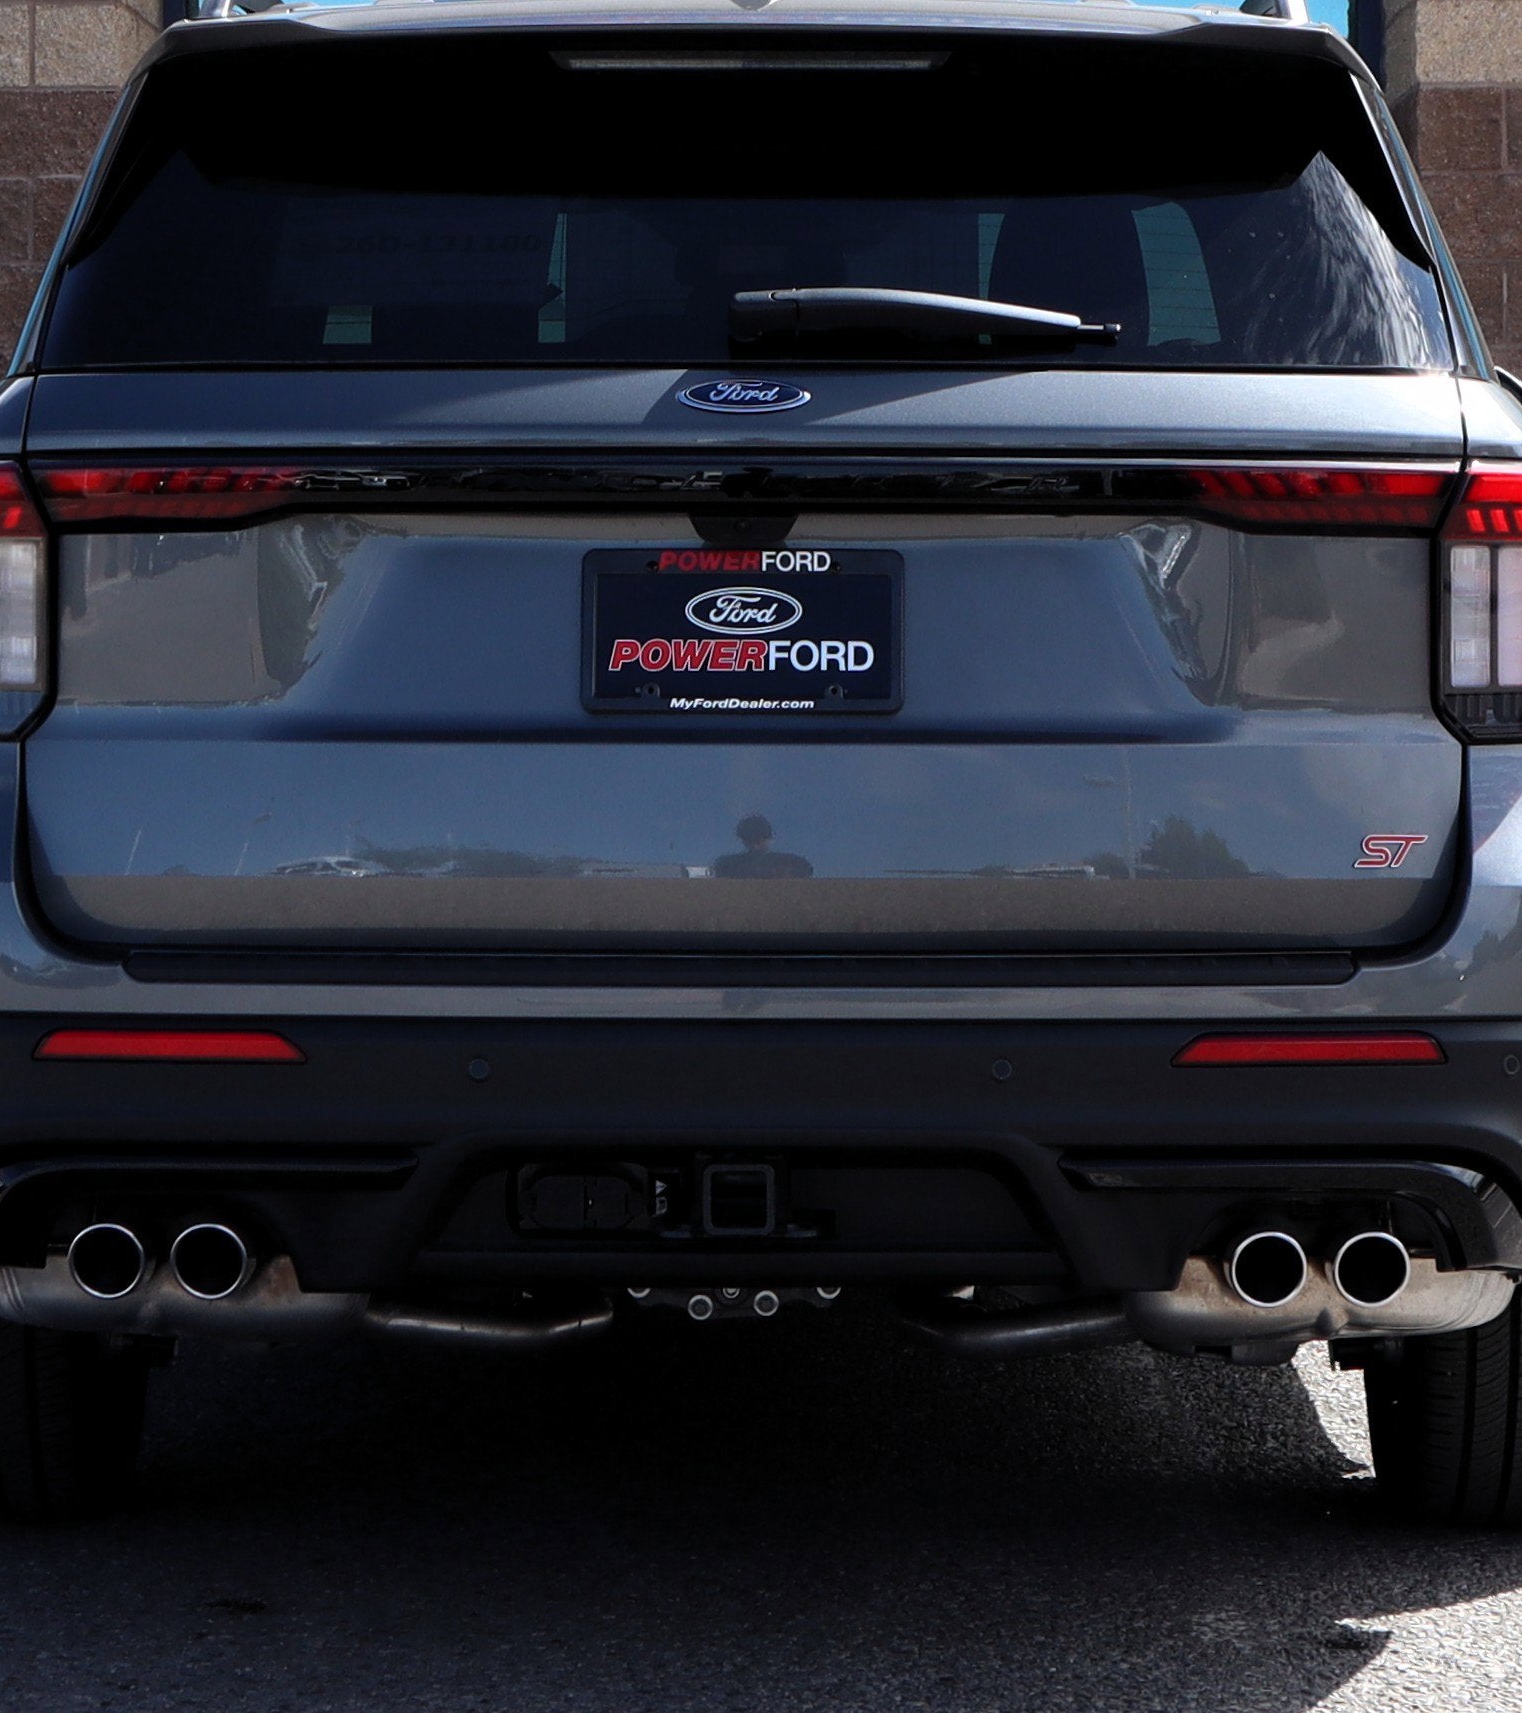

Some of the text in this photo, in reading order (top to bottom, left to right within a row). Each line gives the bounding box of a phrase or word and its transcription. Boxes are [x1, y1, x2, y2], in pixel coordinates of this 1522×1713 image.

[708, 379, 780, 403] Ford
[708, 595, 778, 624] Ford
[669, 697, 815, 710] MyFordDealer.com
[1353, 834, 1429, 868] ST
